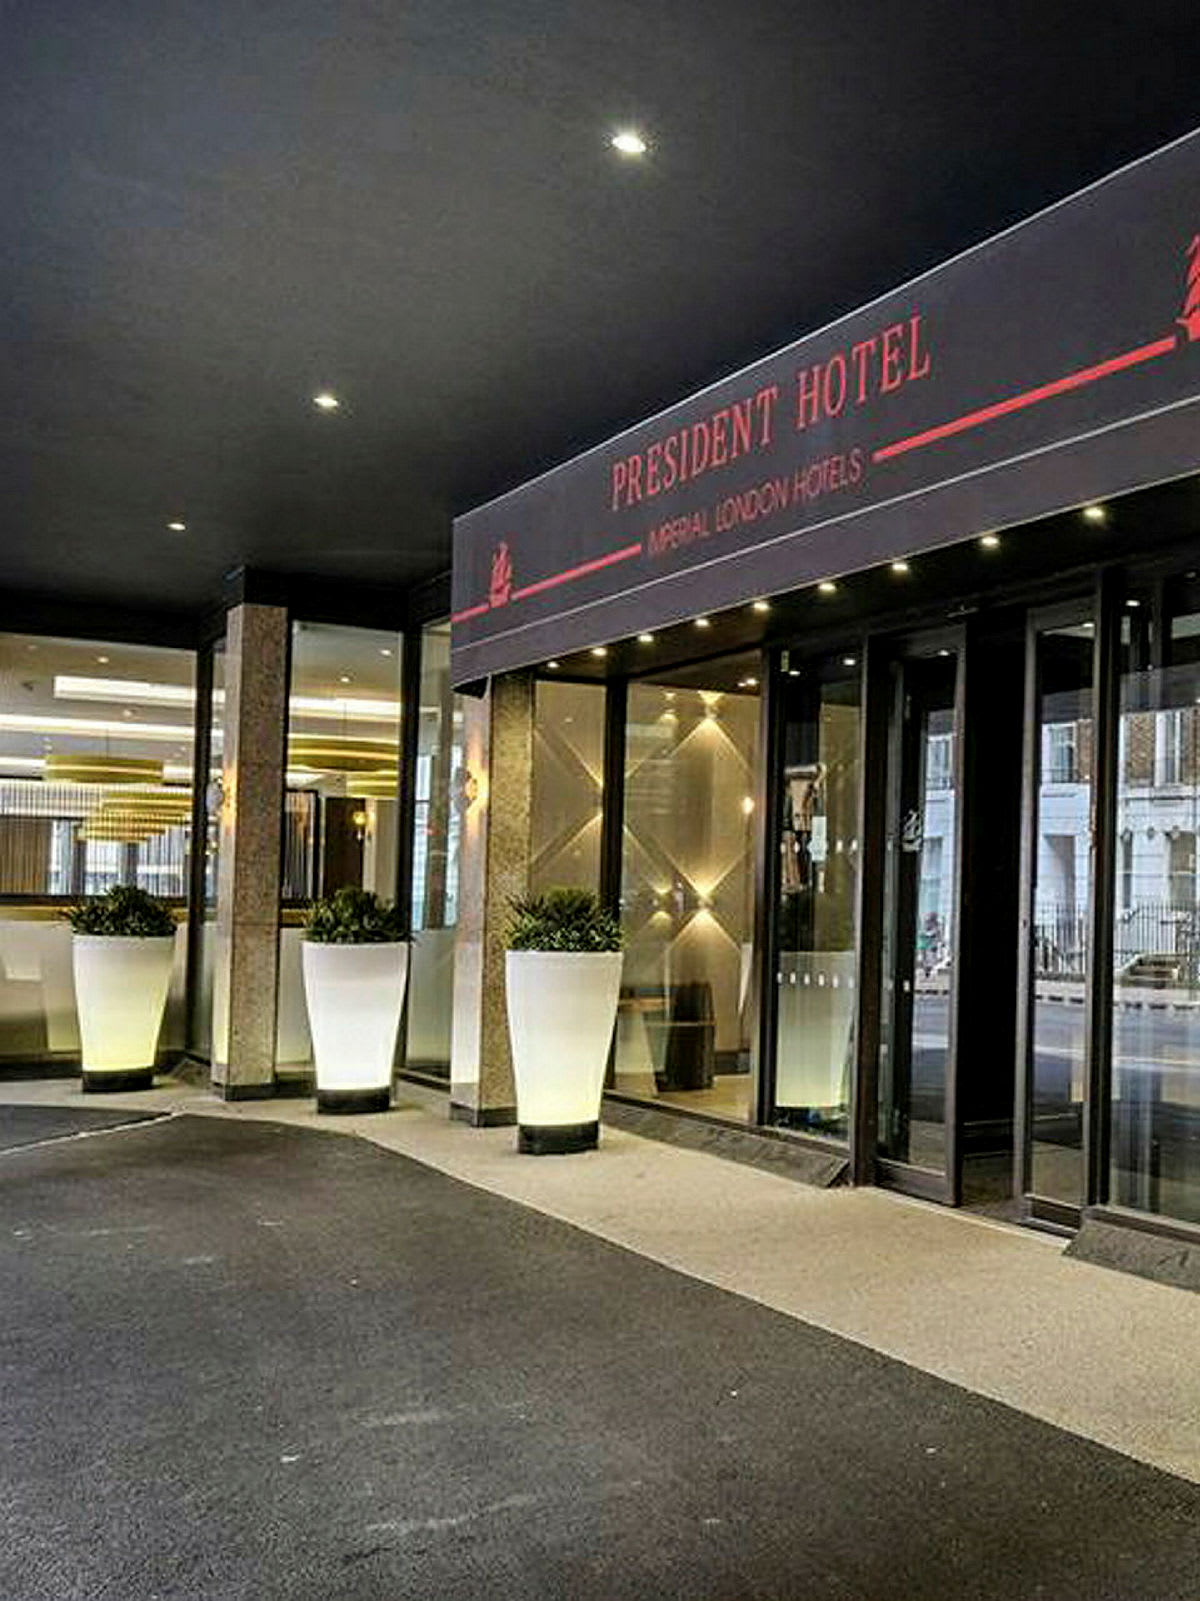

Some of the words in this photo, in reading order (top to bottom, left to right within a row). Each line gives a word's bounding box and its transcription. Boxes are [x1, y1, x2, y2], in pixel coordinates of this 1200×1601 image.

[611, 386, 778, 511] PRESIDENT
[796, 315, 930, 429] HOTEL
[648, 510, 710, 553] IMPERIAL
[715, 477, 788, 532] LONDON
[793, 448, 864, 502] HOTELS
